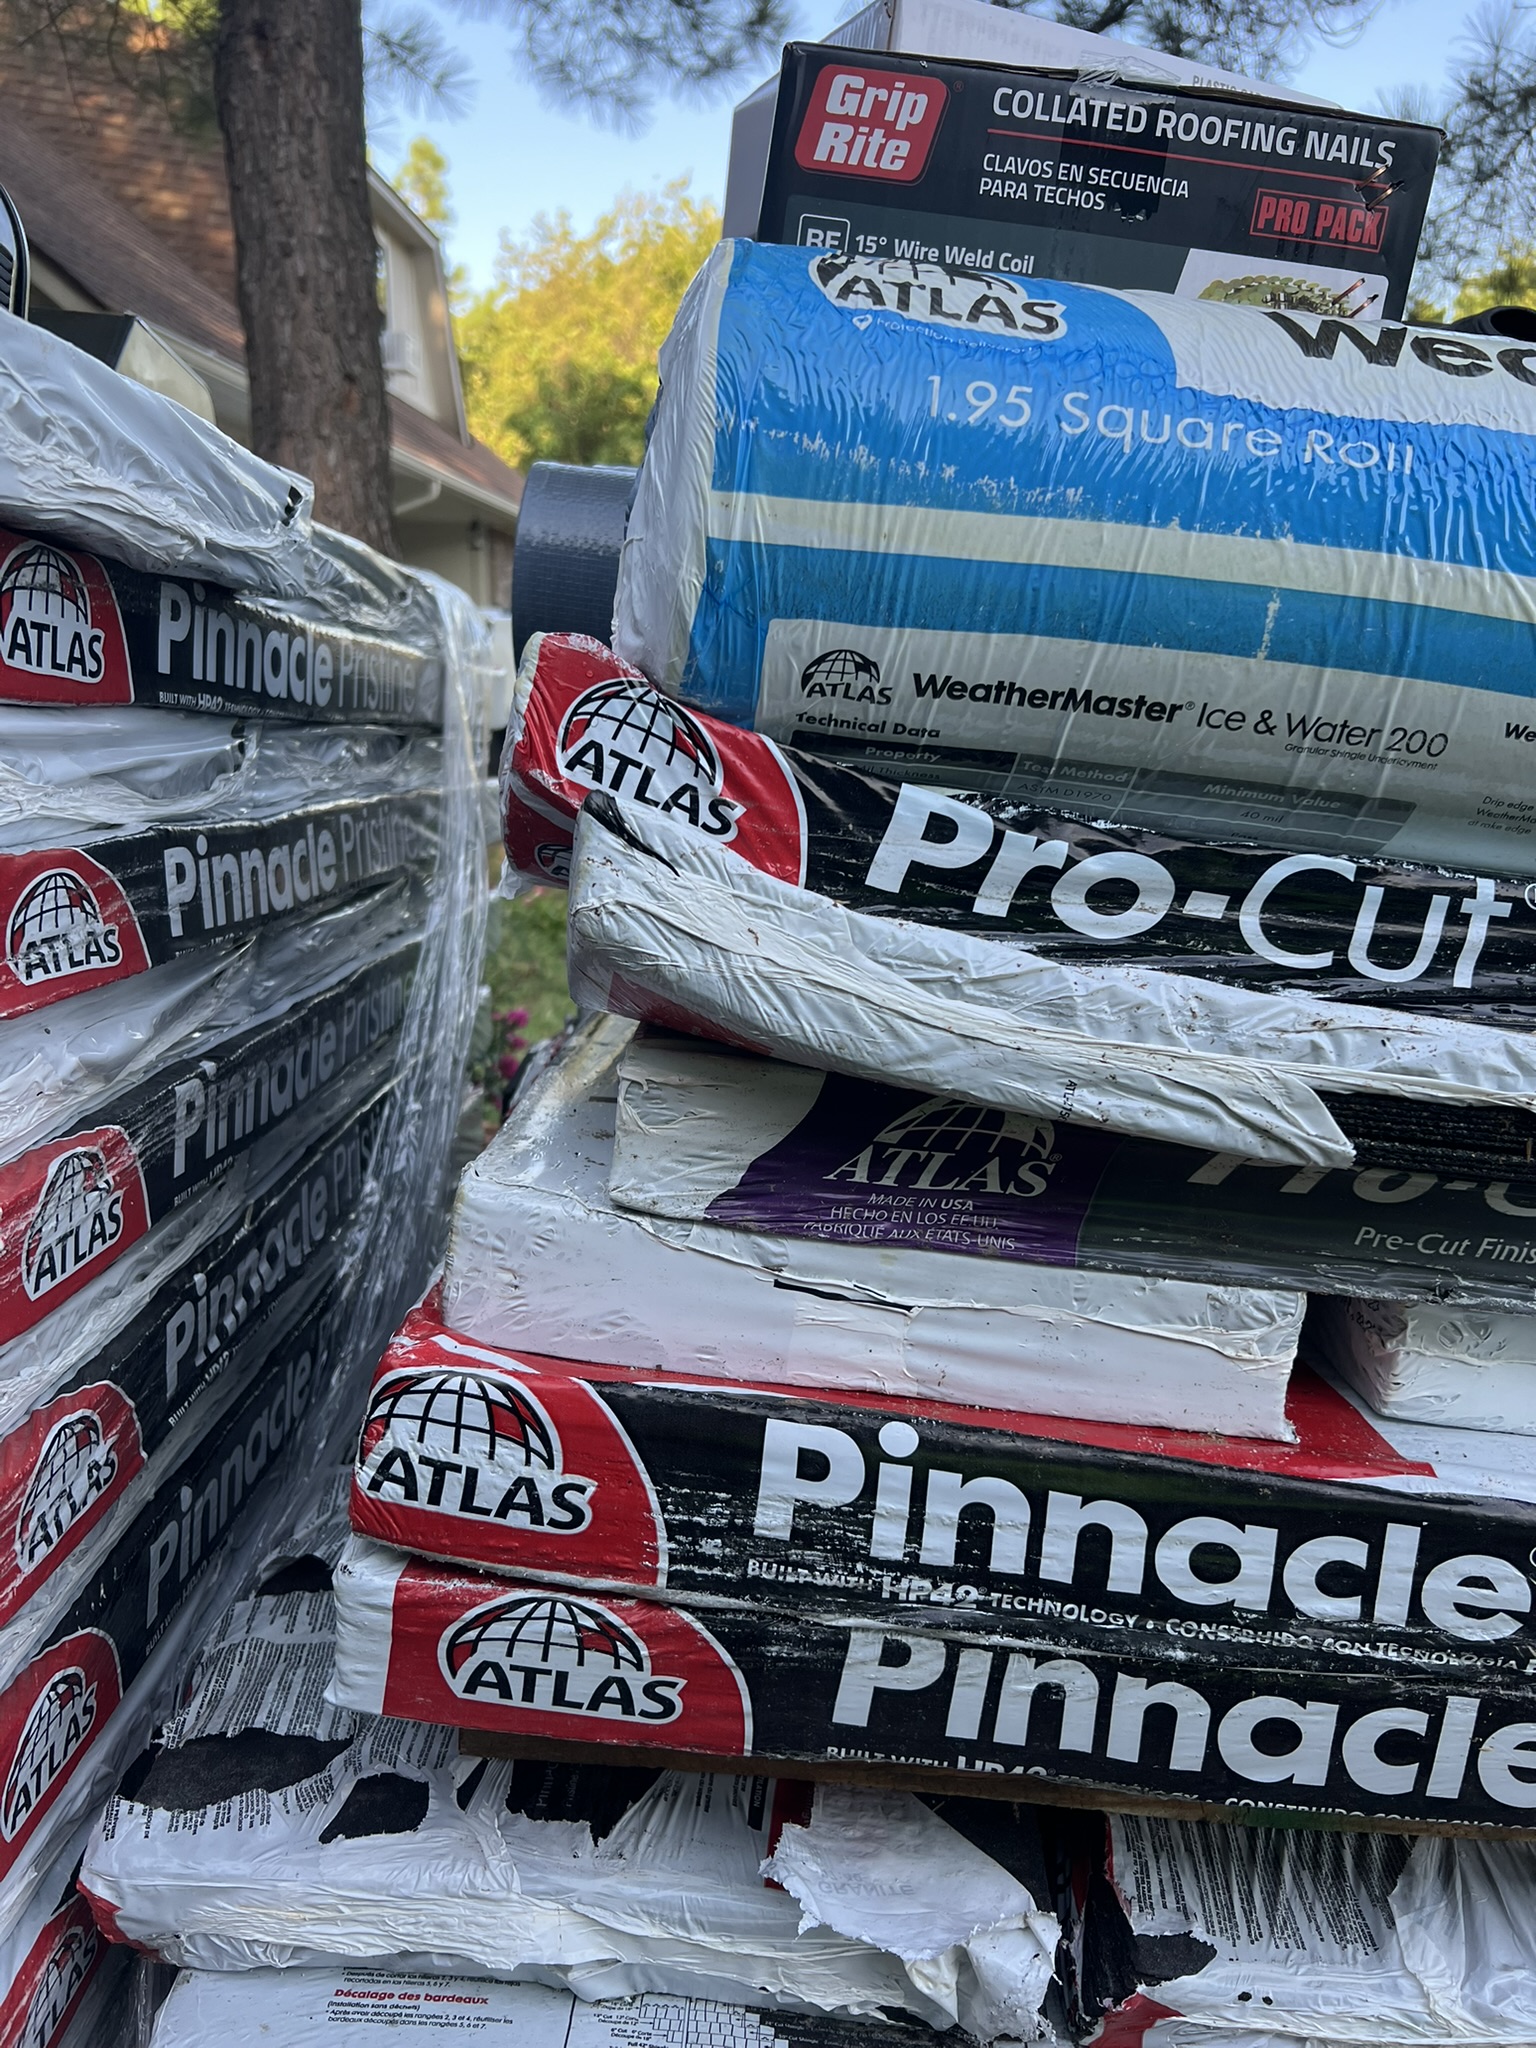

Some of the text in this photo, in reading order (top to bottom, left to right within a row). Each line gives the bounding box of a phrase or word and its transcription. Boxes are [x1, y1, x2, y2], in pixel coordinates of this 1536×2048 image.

[825, 73, 929, 132] Grip
[992, 86, 1397, 169] COLLATED ROOFING NAILS
[812, 122, 911, 171] Rite
[979, 177, 1106, 210] PARA TECHOS
[982, 153, 1190, 198] CLAVOS EN SECUENCIA
[1256, 195, 1383, 246] PRO PACK
[894, 238, 940, 262] Wire
[944, 244, 994, 270] Weld
[998, 252, 1035, 275] Coil
[835, 274, 1060, 336] ATLAS
[927, 374, 1415, 475] 1.95 Square Roll
[8, 616, 103, 679] ATLAS
[157, 581, 333, 708] Pinnacle
[796, 711, 941, 739] Technical Data
[806, 682, 894, 706] ATLAS
[1197, 702, 1247, 731] Ice
[1252, 708, 1278, 737] &
[1286, 712, 1382, 749] Water
[1383, 726, 1449, 759] 200
[865, 746, 942, 763] Property
[1023, 760, 1129, 783] Test Method
[1284, 742, 1331, 757] Granular
[1330, 748, 1367, 762] Shingle
[563, 738, 743, 837] ATLAS
[1017, 782, 1113, 803] ASTM D1970
[1202, 782, 1341, 810] Minimum Value
[1482, 795, 1535, 812] Drip edge
[1239, 810, 1285, 825] 40 mil
[163, 822, 337, 938] Pinnacle
[863, 781, 1513, 990] Pro-Cut
[25, 928, 121, 981] ATLAS
[173, 1014, 337, 1179] Pinnacle
[830, 1205, 888, 1221] HECHO
[890, 1210, 914, 1223] EN
[916, 1211, 946, 1225] LOS
[867, 1192, 974, 1211] MADE IN USA
[33, 1195, 123, 1295] ATLAS
[889, 1229, 921, 1240] AUX
[924, 1226, 1016, 1251] ÉTATS-UNIS
[1353, 1226, 1471, 1257] Pre-Cut
[27, 1438, 117, 1563] ATLAS
[146, 1350, 312, 1630] Pinnacle
[366, 1447, 590, 1533] ATLAS
[753, 1417, 1533, 1642] Pinnacle
[990, 1592, 1140, 1630] TECHNOLOGY
[462, 1659, 679, 1722] ATLAS
[10, 1687, 95, 1835] ATLAS
[334, 1988, 490, 2005] Décalage des bardeaux
